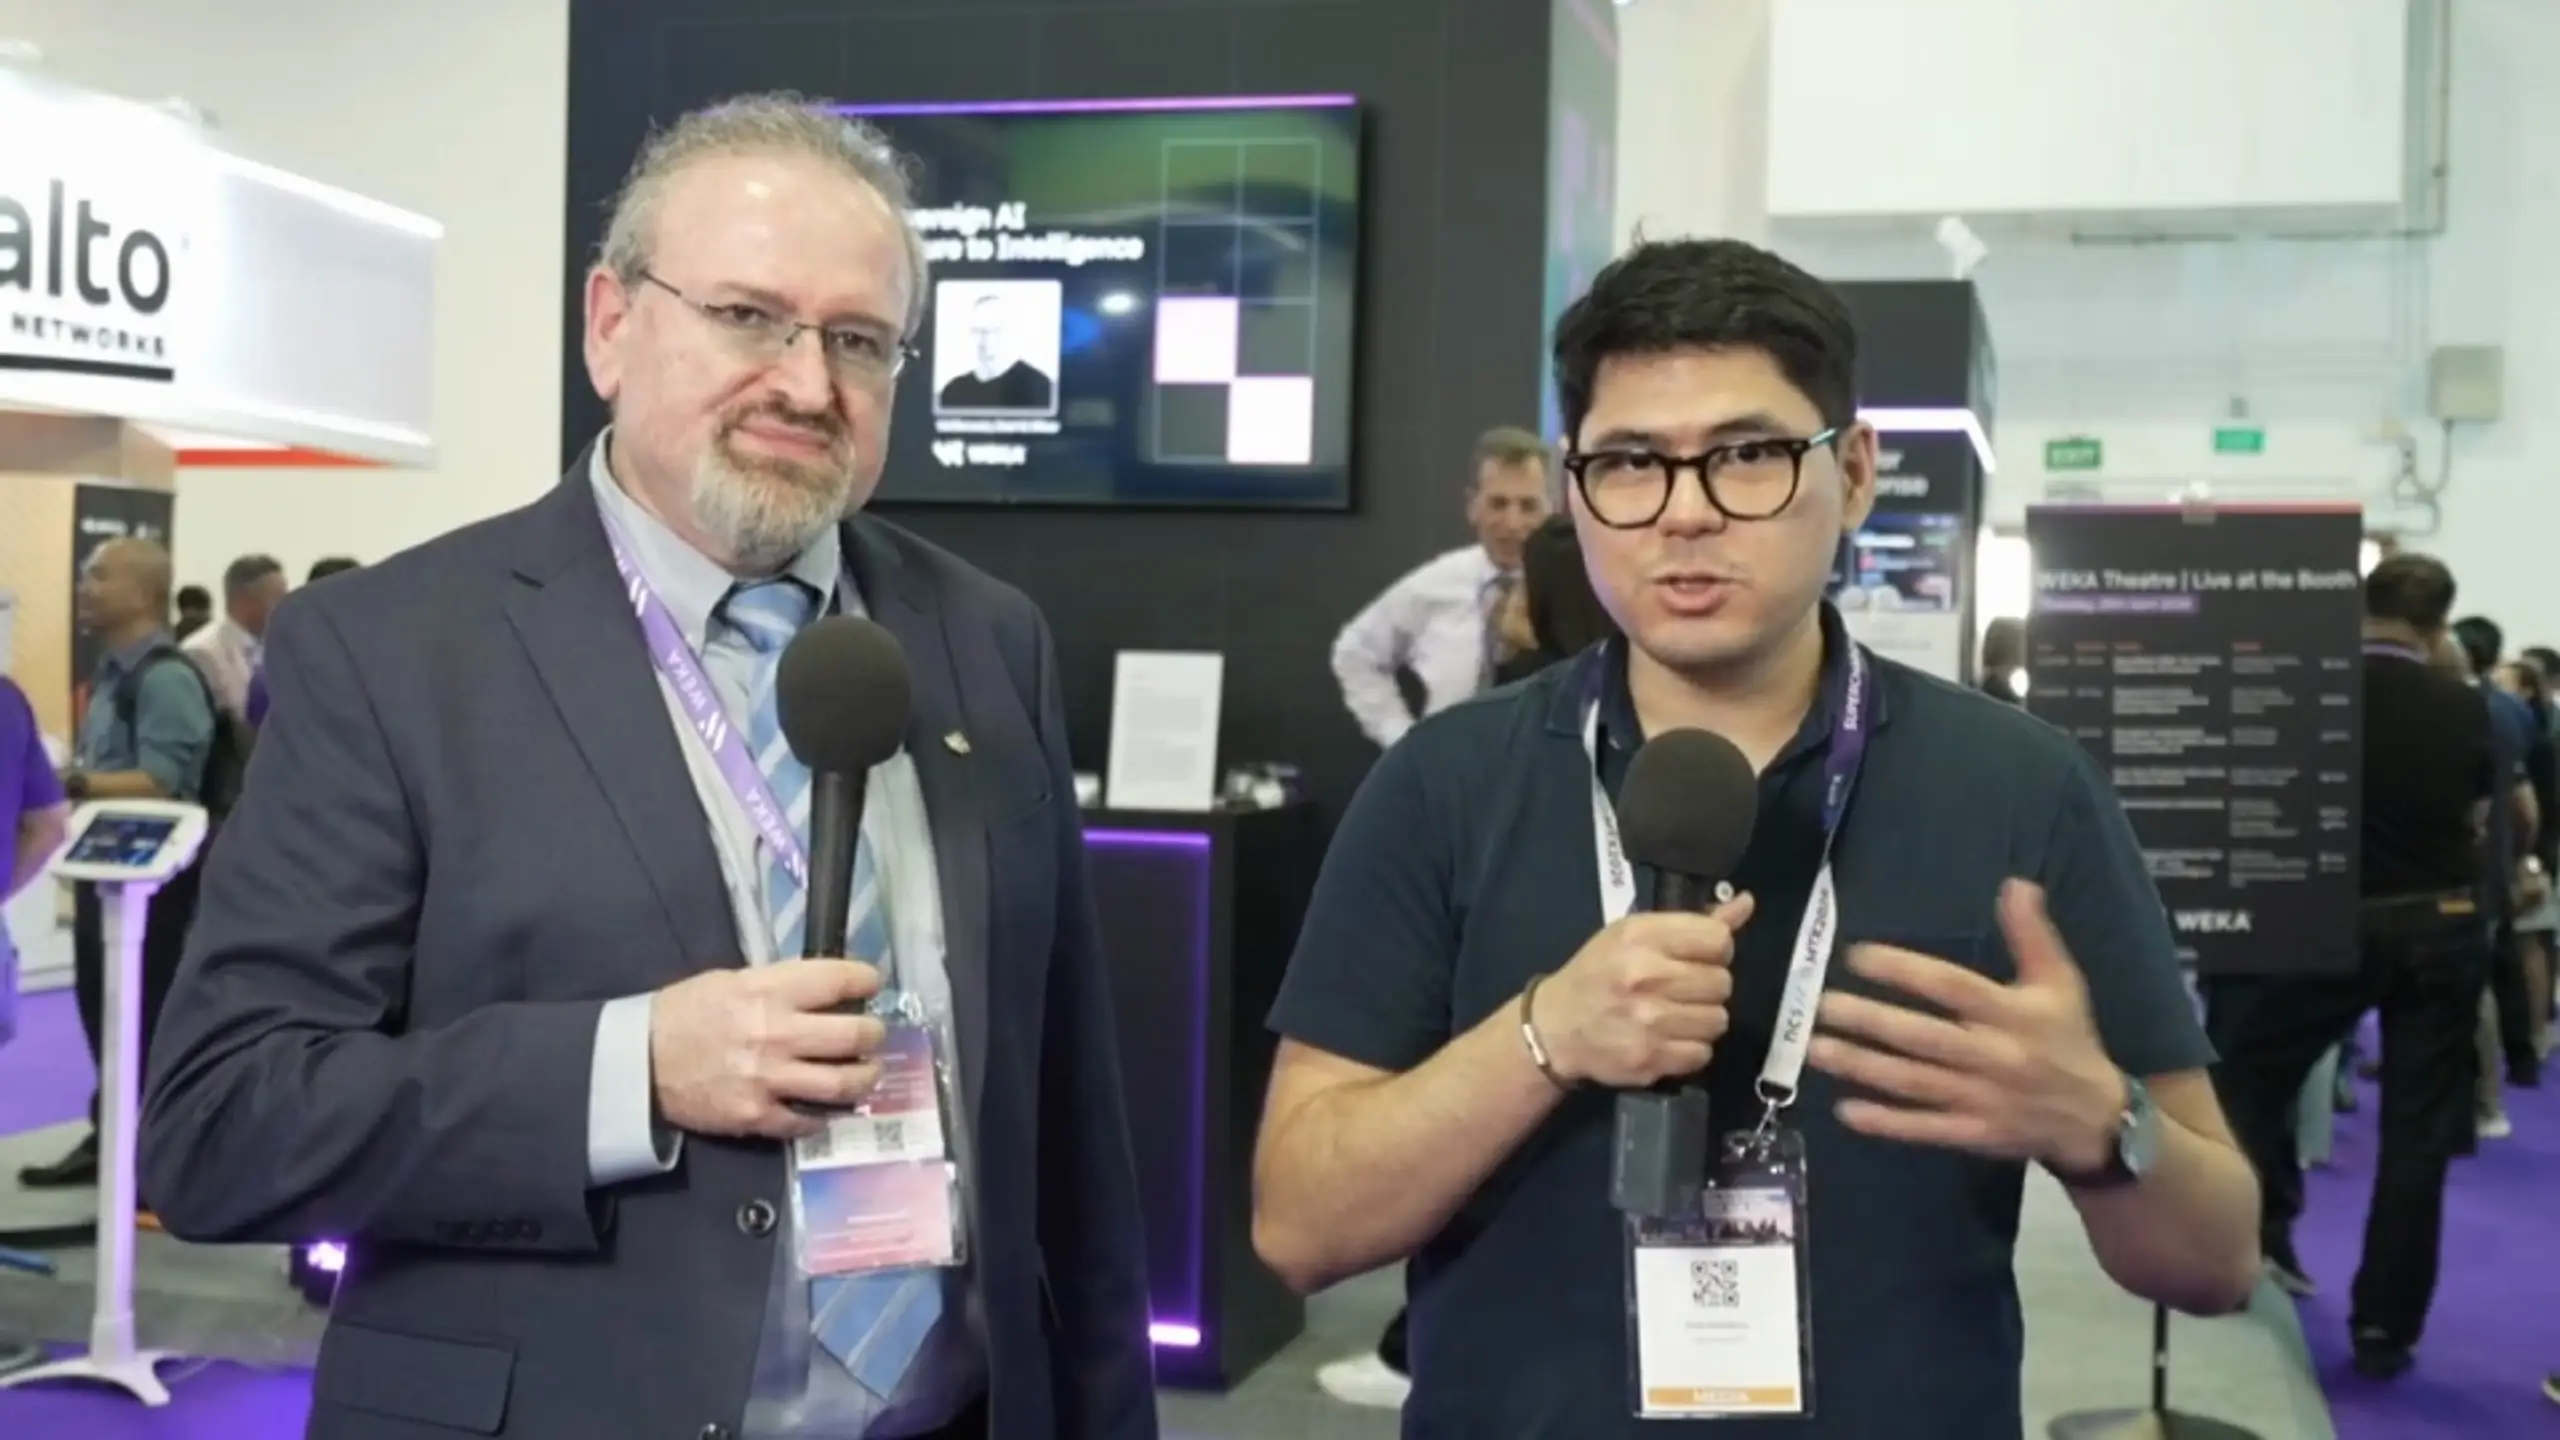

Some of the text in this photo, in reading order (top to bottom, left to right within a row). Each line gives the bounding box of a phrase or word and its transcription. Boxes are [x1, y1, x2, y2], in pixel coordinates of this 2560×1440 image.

[996, 202, 1026, 229] AI
[996, 231, 1145, 266] Intelligence
[11, 312, 165, 357] NETWORKS
[2103, 569, 2177, 591] Theatre
[2193, 570, 2232, 590] Live
[2236, 571, 2259, 590] at
[2261, 570, 2293, 590] the
[2297, 569, 2357, 590] Booth
[667, 649, 708, 711] WEKA
[746, 786, 787, 855] WEKA
[2174, 911, 2250, 932] WEKA
